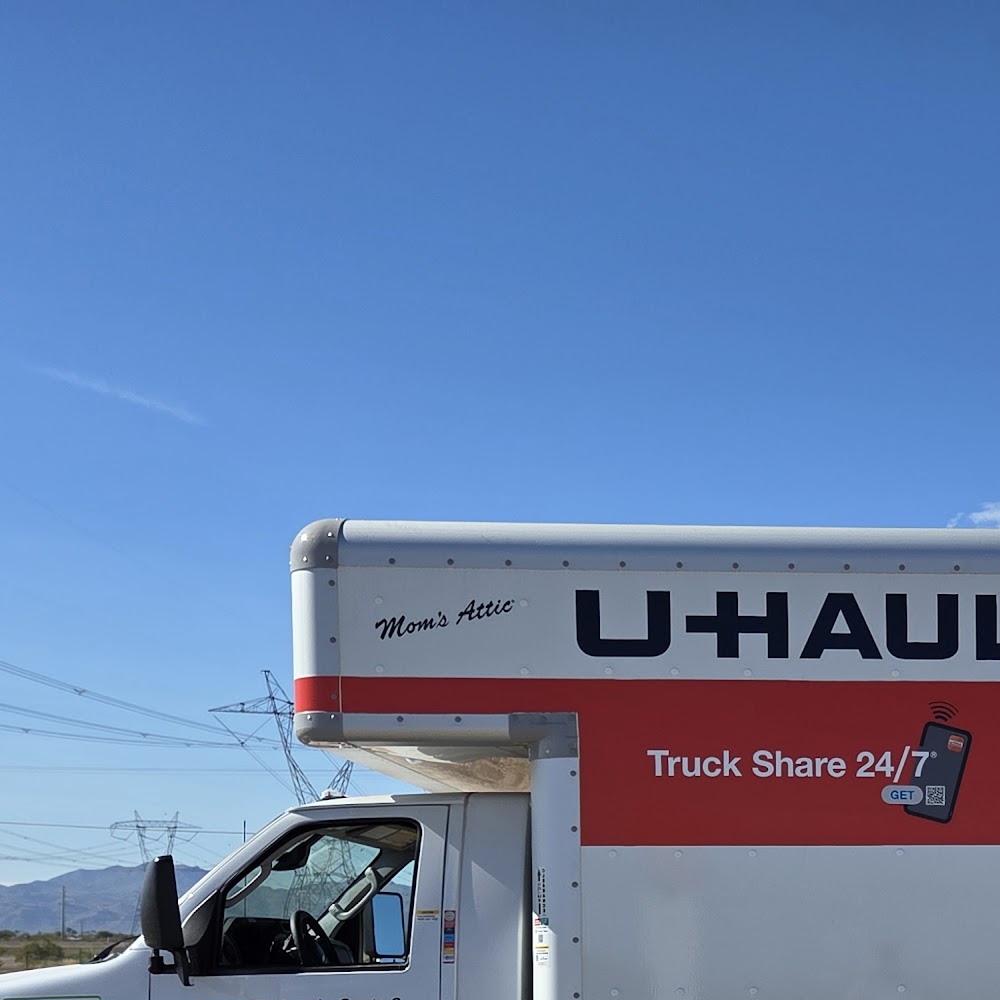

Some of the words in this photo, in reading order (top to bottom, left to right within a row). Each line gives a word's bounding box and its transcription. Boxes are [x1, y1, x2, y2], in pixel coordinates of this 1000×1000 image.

[375, 611, 449, 640] Mom's
[646, 750, 743, 778] Truck
[751, 750, 847, 778] Share
[890, 790, 915, 801] GET
